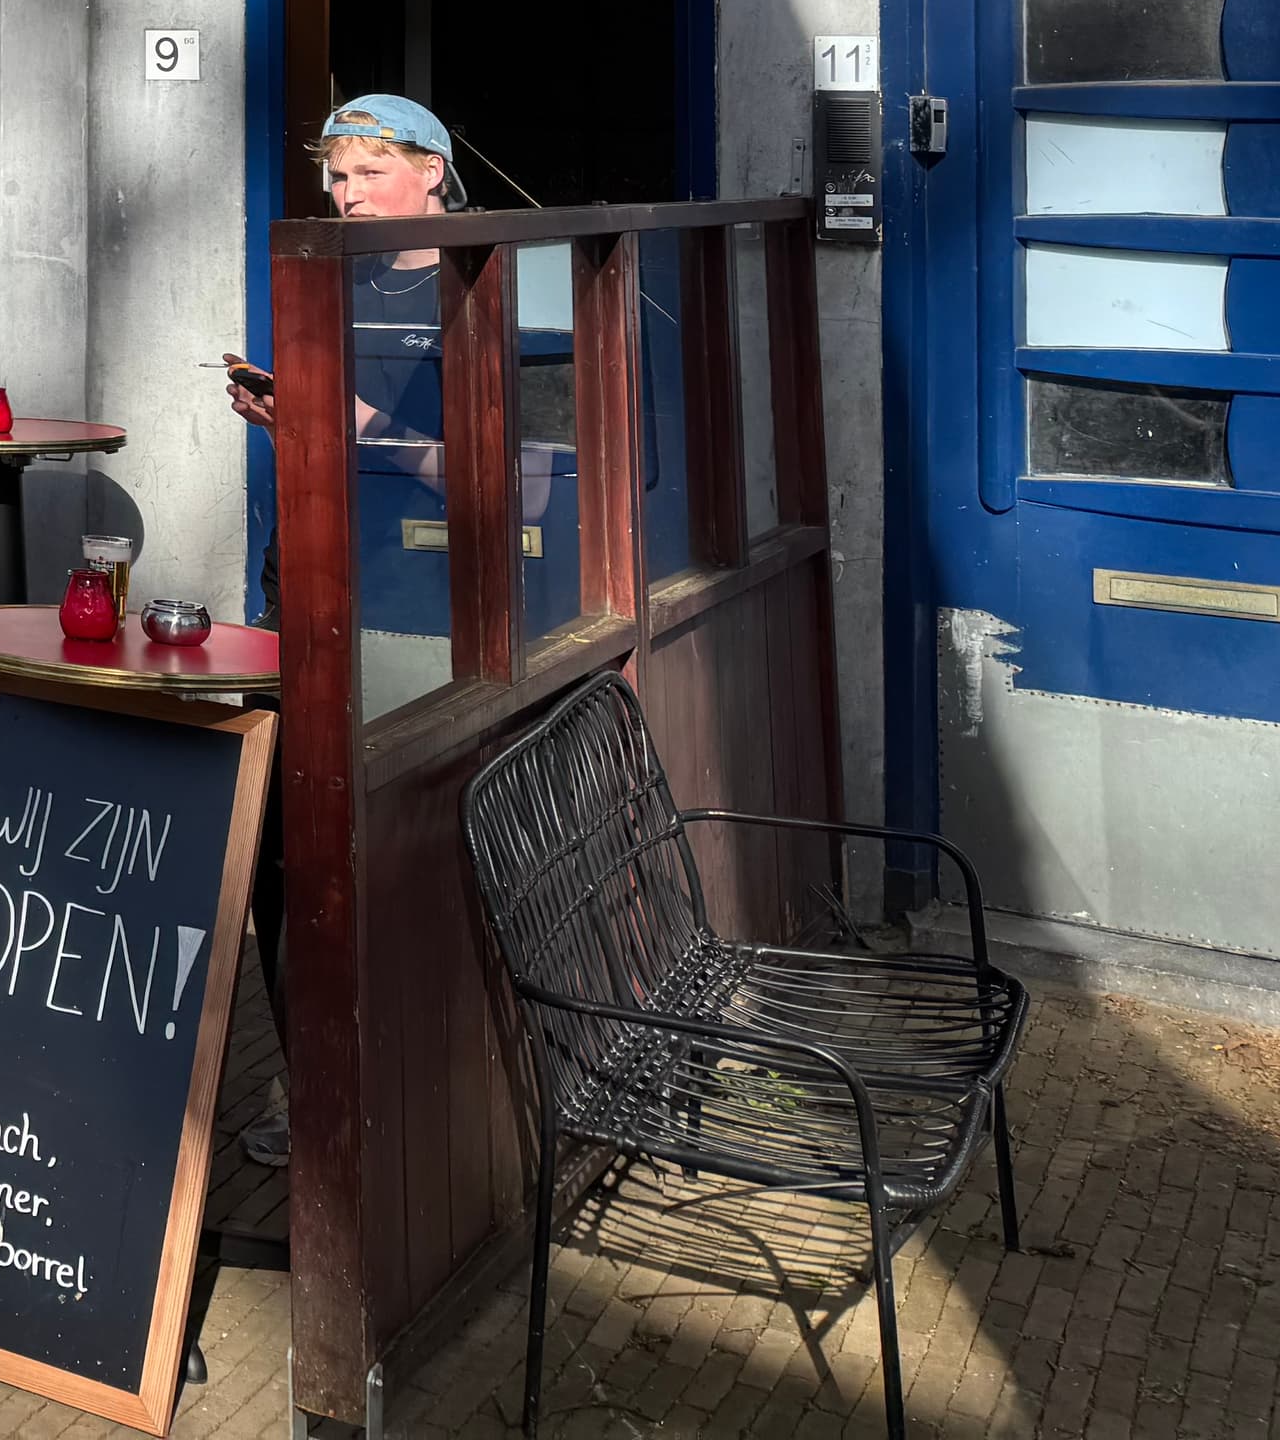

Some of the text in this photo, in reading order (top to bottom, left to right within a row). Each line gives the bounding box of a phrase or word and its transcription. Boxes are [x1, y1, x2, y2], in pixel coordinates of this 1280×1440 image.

[155, 37, 179, 72] 9
[822, 44, 860, 83] 11
[64, 798, 172, 894] ZIJN
